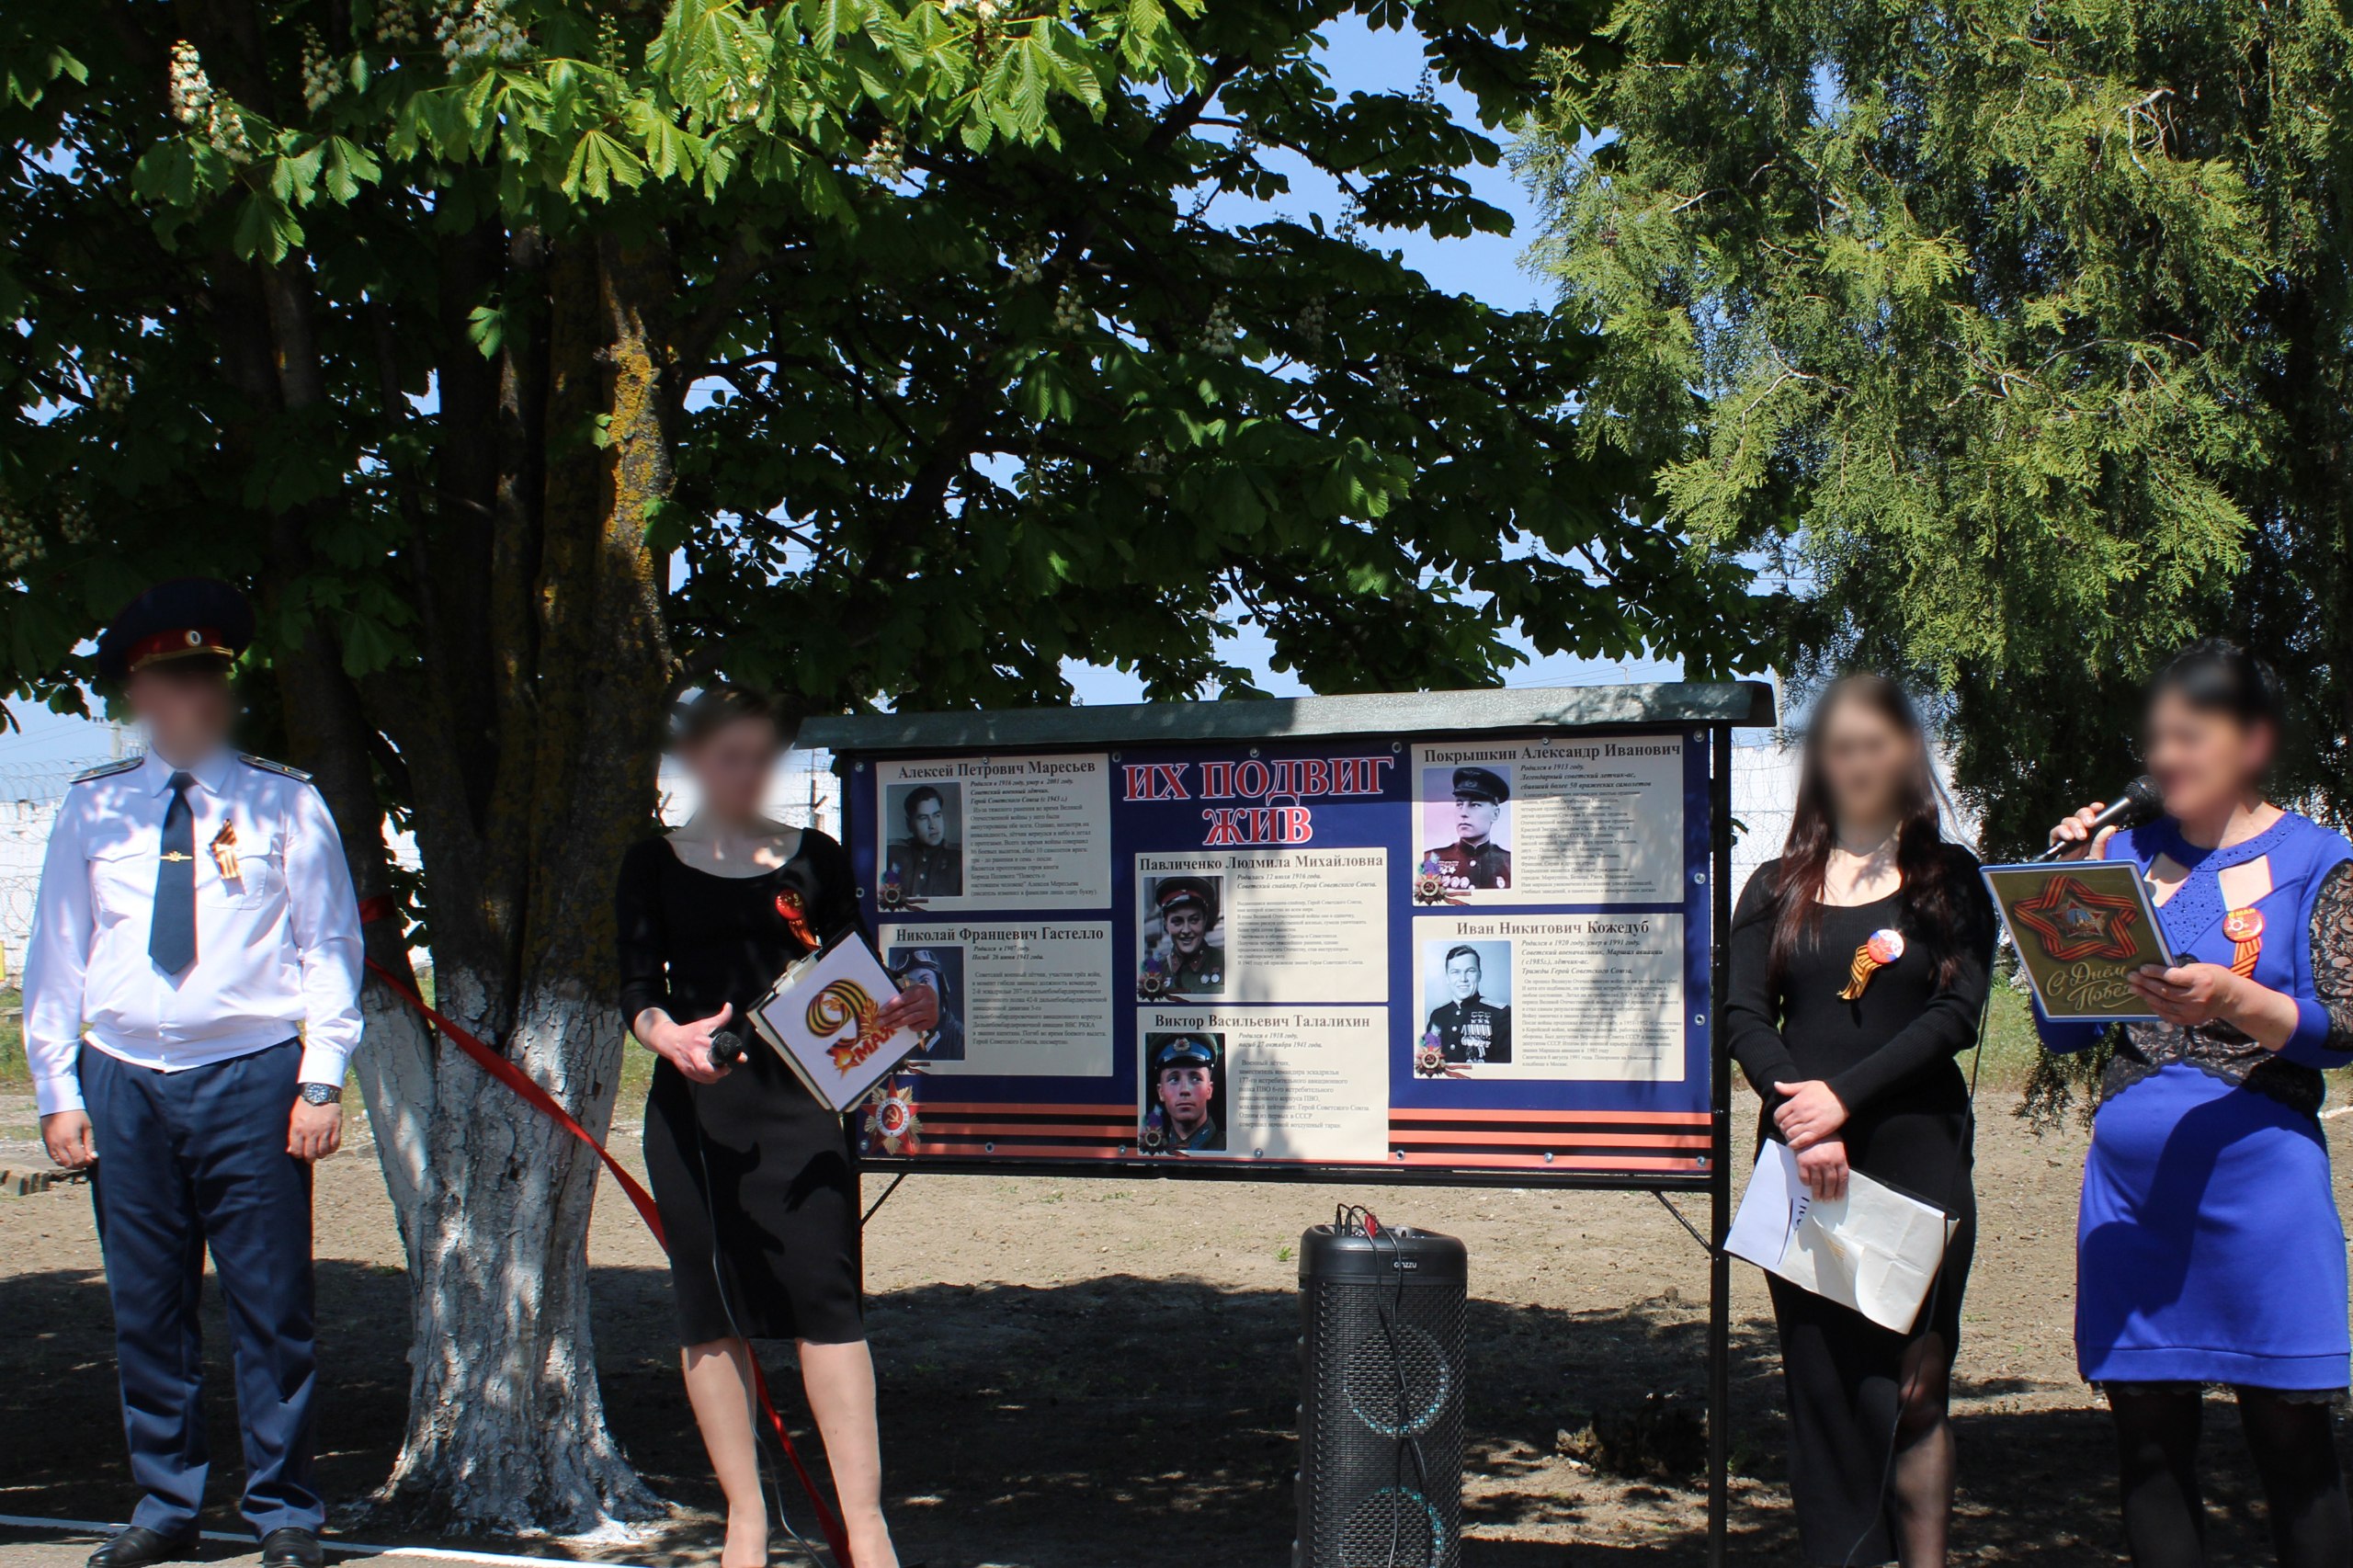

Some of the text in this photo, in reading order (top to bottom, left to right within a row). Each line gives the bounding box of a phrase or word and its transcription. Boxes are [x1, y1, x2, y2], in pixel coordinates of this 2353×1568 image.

[1425, 744, 1681, 764] Покрышкин Александр Иванович
[898, 761, 1096, 778] Алексей Петрович Маресьев
[1121, 756, 1394, 806] ИХ ПОДВИГ
[1201, 805, 1313, 846] ЖИВ
[1140, 855, 1383, 870] Павличенко Людмила Михайловна
[896, 927, 1104, 943] Николай Францевич Гастелло
[1457, 920, 1650, 937] Иван Никитович Кожедуб
[1155, 1015, 1370, 1029] Виктор Васильевич Талалихин
